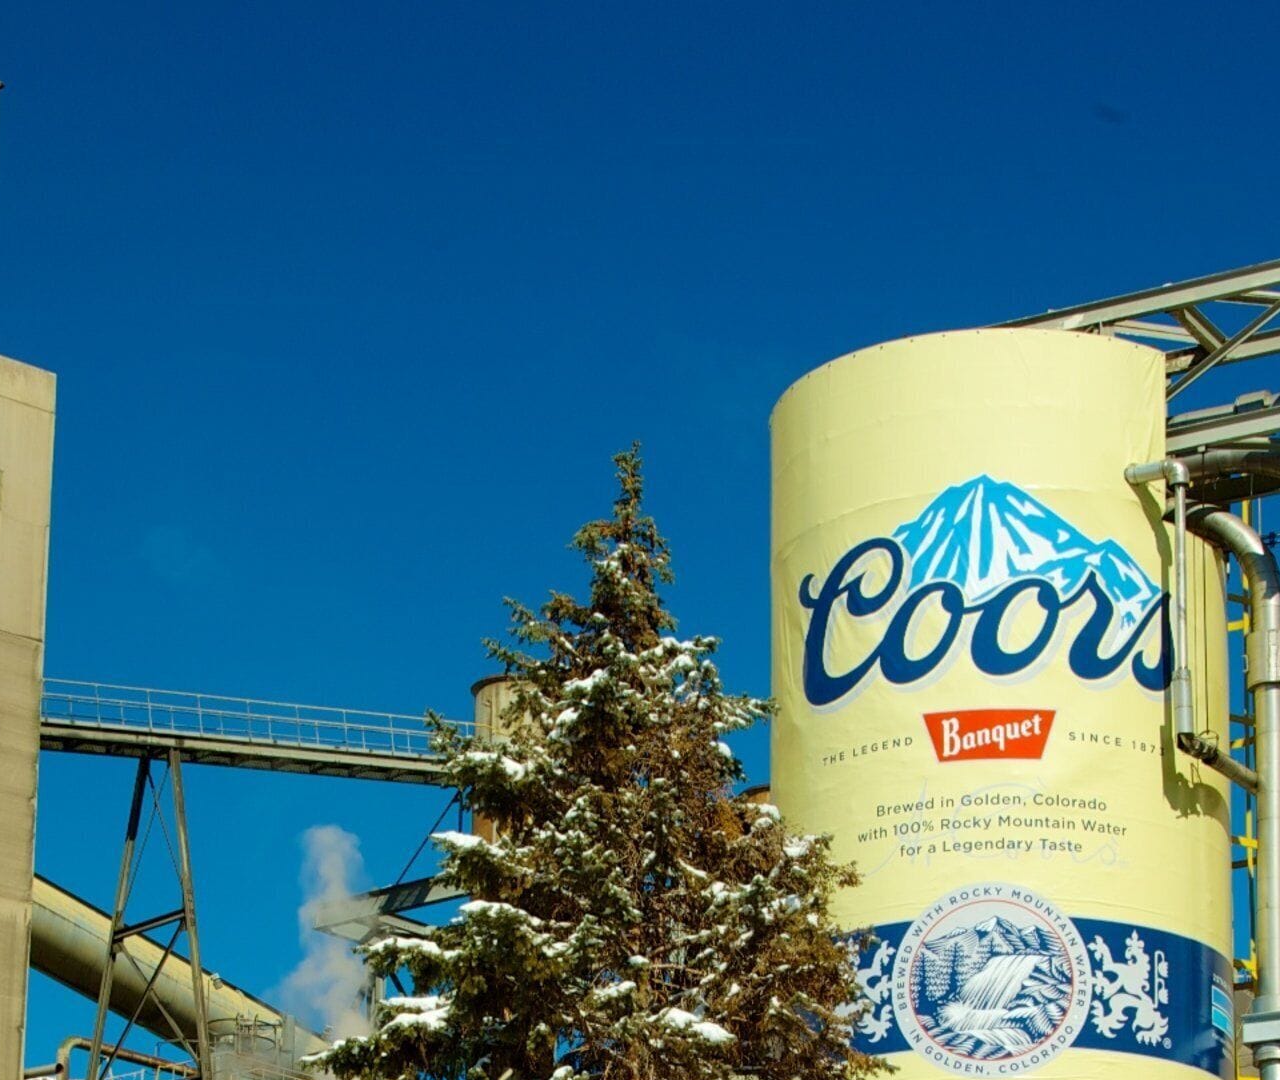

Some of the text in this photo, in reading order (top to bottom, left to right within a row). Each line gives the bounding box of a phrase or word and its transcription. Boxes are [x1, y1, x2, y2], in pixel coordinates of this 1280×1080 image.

[799, 537, 1174, 706] Coors
[941, 713, 1043, 757] Banquet
[1068, 731, 1122, 747] SINCE
[822, 736, 914, 767] THE LEGEND
[876, 793, 1108, 817] Brewed in Golden, Colorado
[857, 815, 1128, 843] with 100% Rocky Mountain Water
[900, 838, 1083, 857] for a Legendary Taste
[896, 886, 1087, 1011] BREWED WITH ROCKY MOUNTAIN WATER
[910, 1024, 1075, 1076] IN GOLDEN, COLORADO
